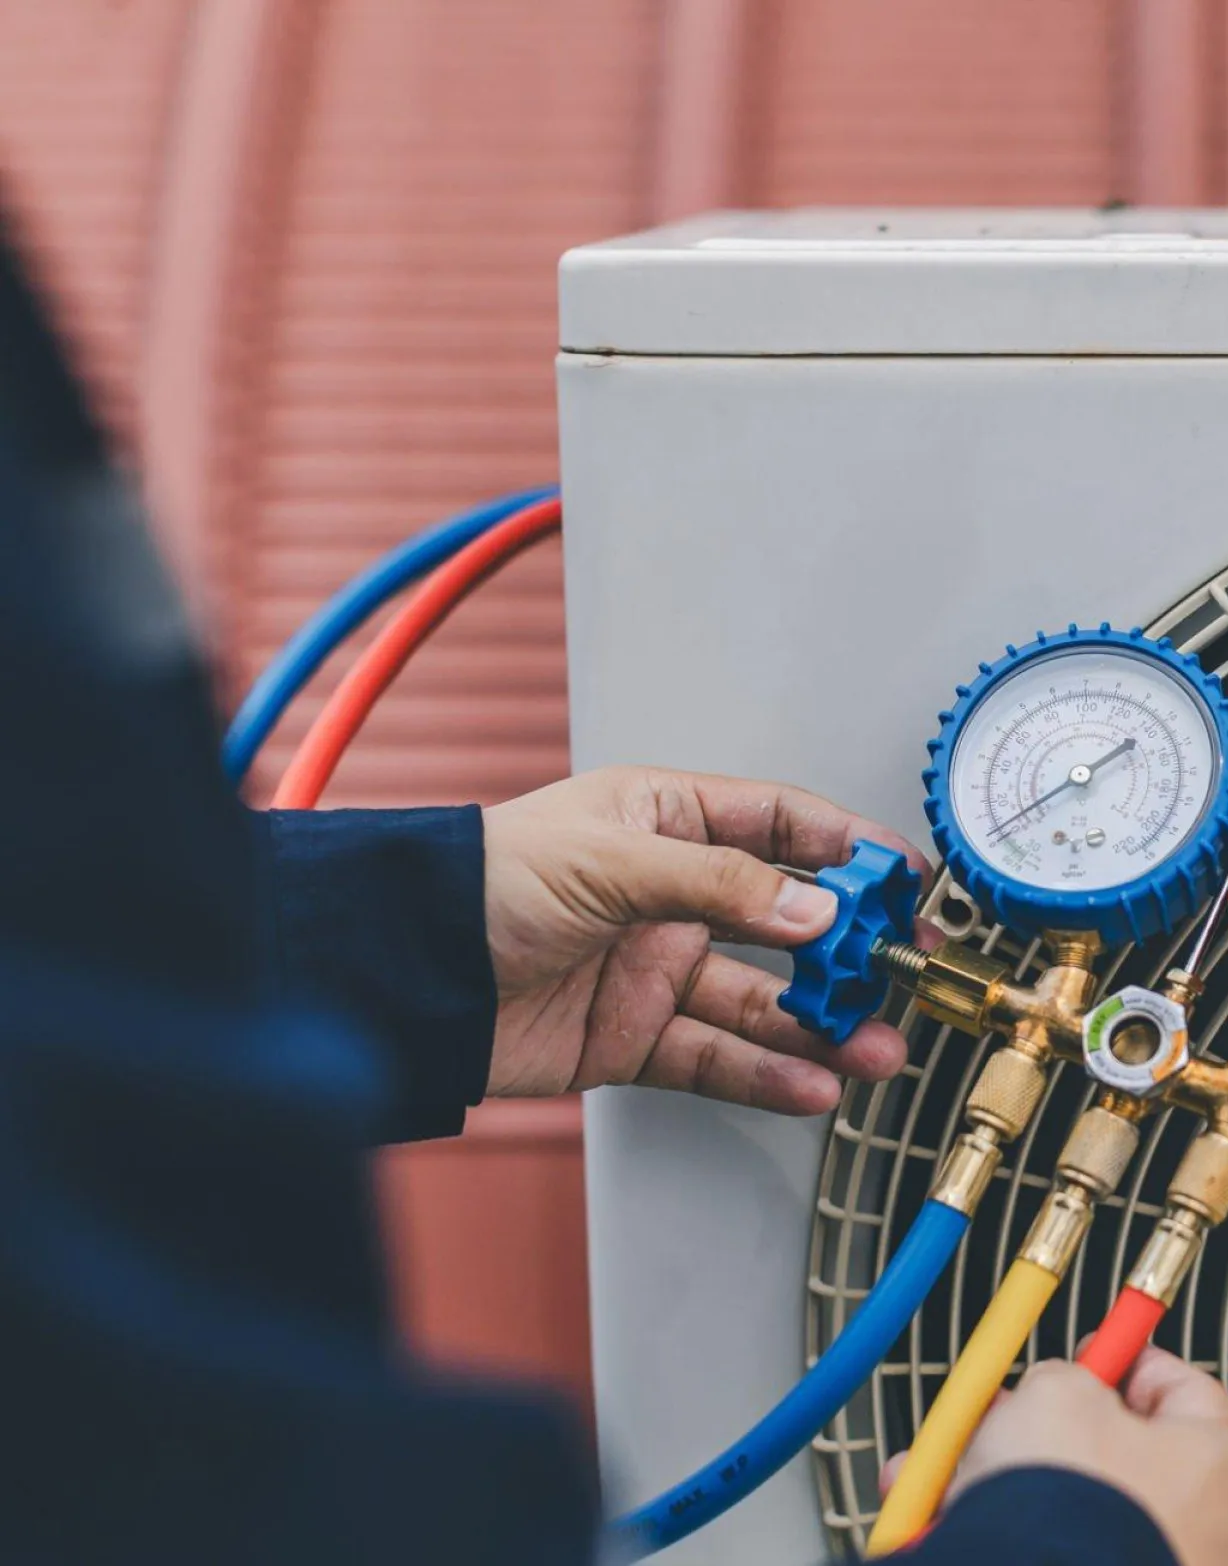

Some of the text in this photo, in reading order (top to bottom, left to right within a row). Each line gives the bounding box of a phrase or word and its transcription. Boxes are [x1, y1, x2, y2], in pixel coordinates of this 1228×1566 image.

[1076, 702, 1098, 713] 100
[1110, 706, 1131, 720] 120
[1167, 710, 1178, 722] 10
[1139, 720, 1159, 739] 140
[1015, 730, 1032, 745] 60
[1157, 746, 1170, 768] 160
[1000, 760, 1012, 774] 40
[1158, 778, 1172, 799] 180
[997, 792, 1009, 808] 20
[1140, 810, 1160, 832] 200
[1168, 826, 1180, 836] 14
[1112, 835, 1136, 854] 220
